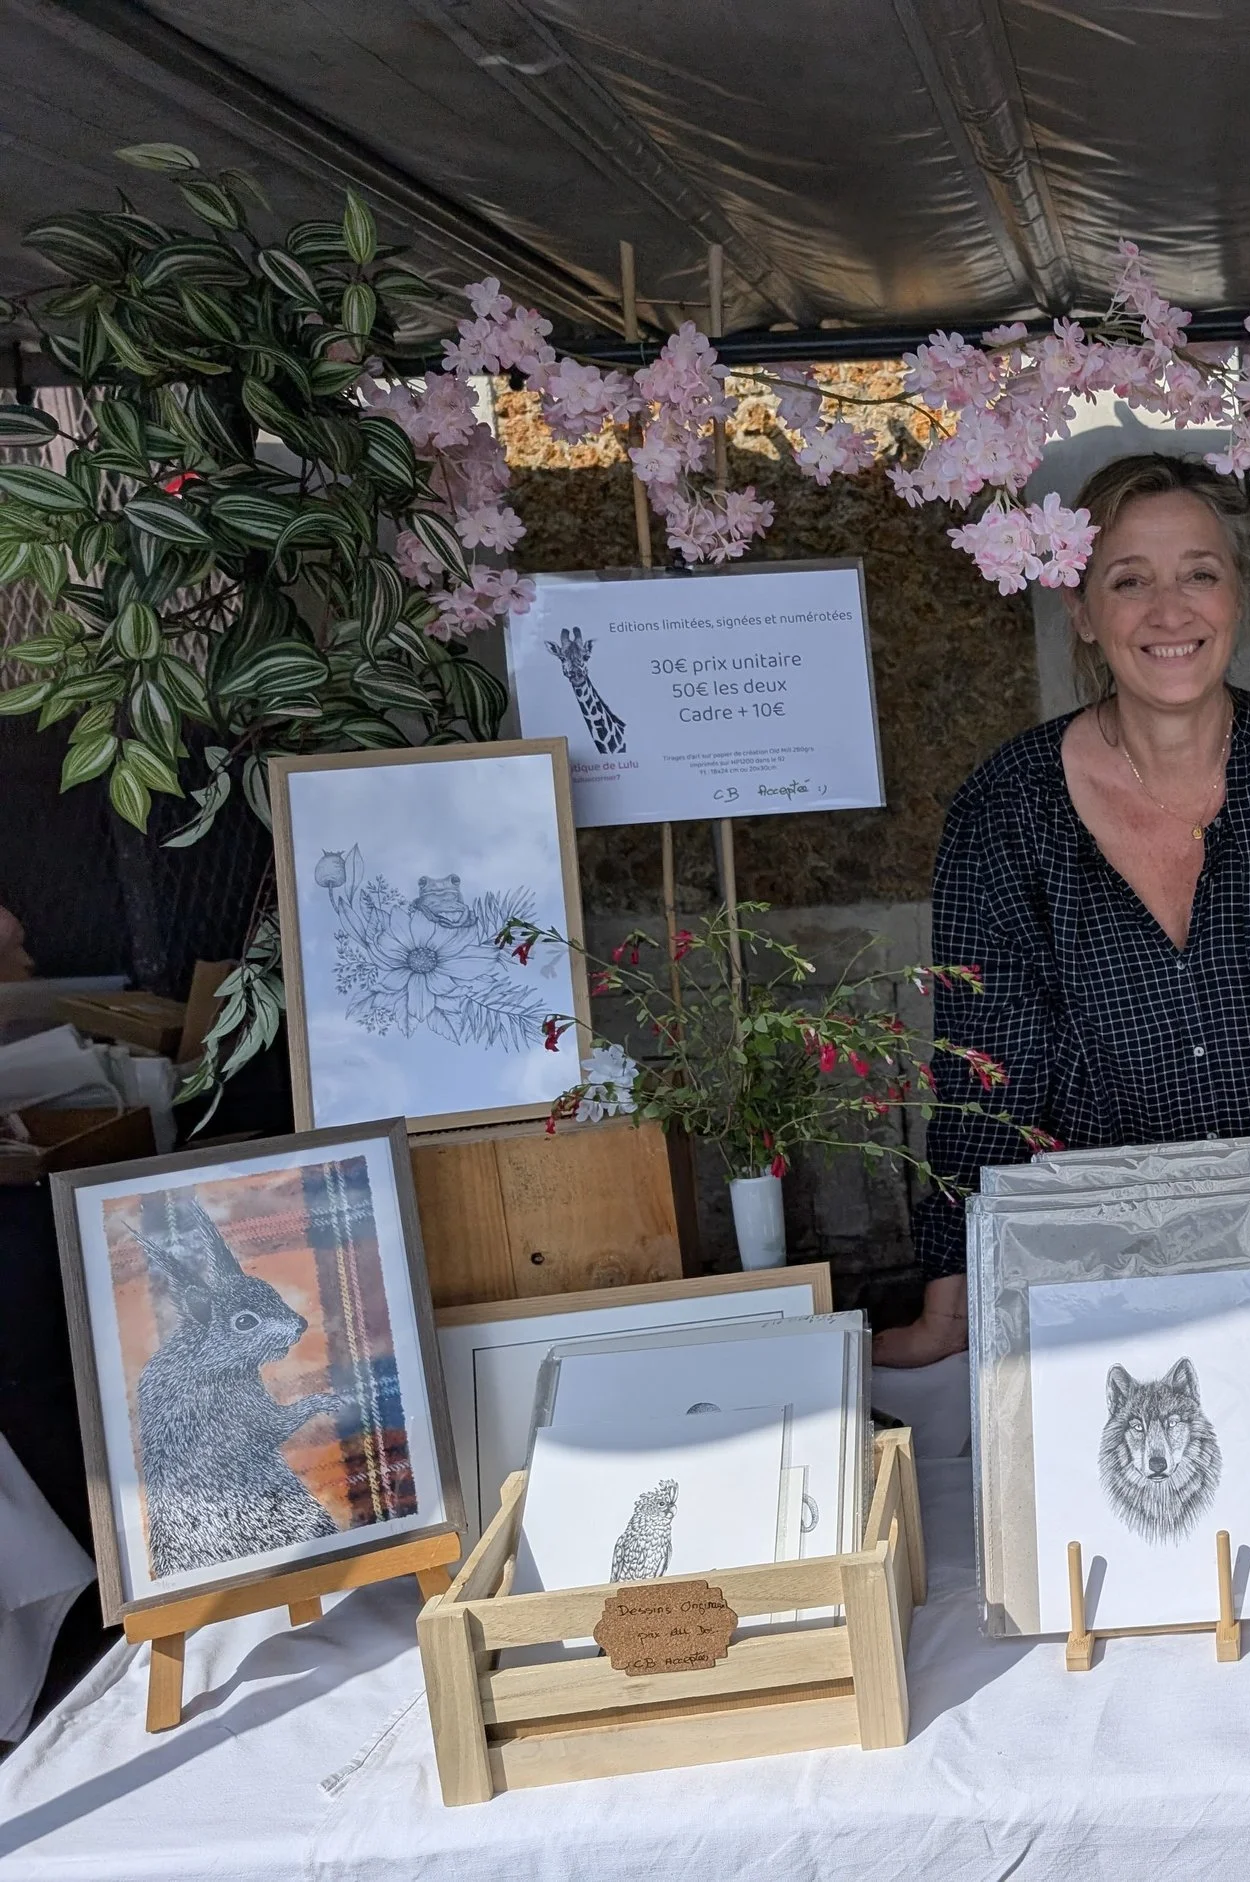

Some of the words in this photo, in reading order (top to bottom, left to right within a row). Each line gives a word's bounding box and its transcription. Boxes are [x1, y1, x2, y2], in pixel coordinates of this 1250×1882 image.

[609, 621, 660, 633] Editions
[662, 618, 714, 630] limitées,
[716, 615, 762, 629] signées
[764, 614, 778, 625] et
[780, 610, 853, 624] numérotées
[650, 658, 688, 675] 30€
[693, 656, 728, 676] prix
[732, 652, 802, 670] unitaire
[672, 682, 709, 698] 50€
[713, 680, 739, 696] les
[743, 678, 787, 694] deux
[679, 705, 733, 722] Cadre
[738, 707, 748, 717] +
[752, 702, 786, 718] 10€
[602, 762, 616, 770] de
[618, 760, 639, 769] Lulu
[713, 787, 740, 803] CB
[617, 1604, 672, 1617] Dessins
[637, 1632, 661, 1646] prix
